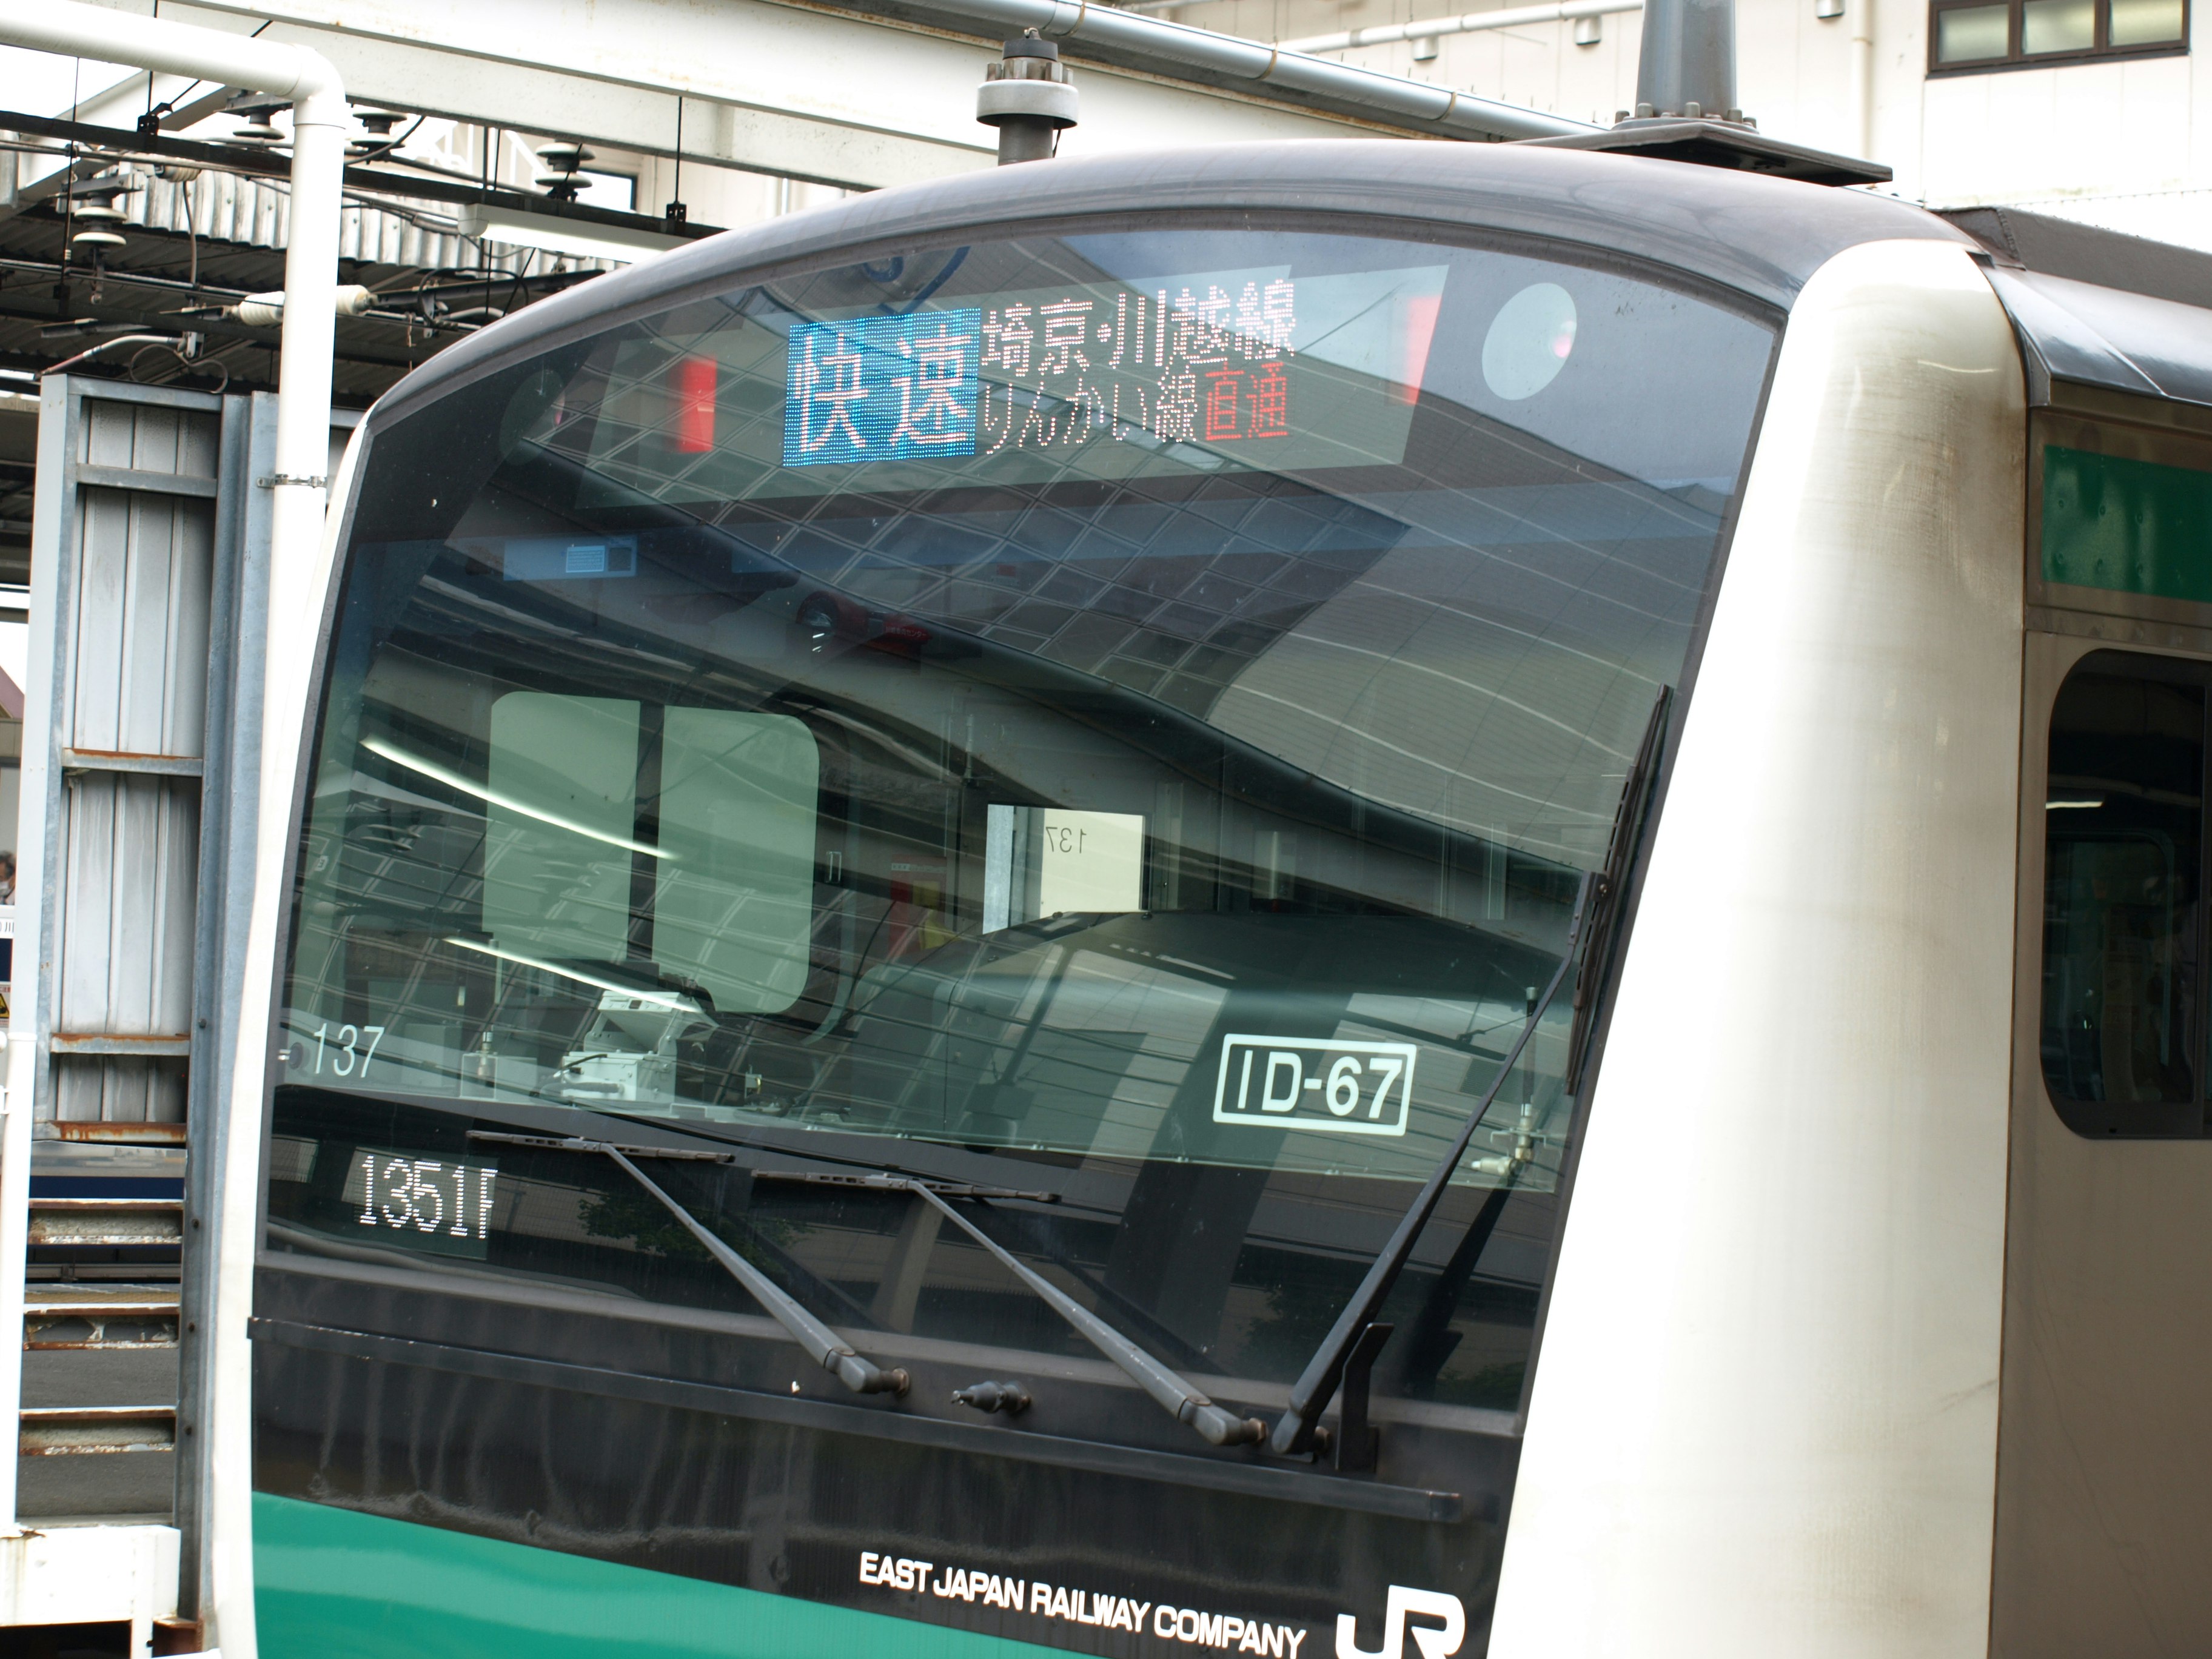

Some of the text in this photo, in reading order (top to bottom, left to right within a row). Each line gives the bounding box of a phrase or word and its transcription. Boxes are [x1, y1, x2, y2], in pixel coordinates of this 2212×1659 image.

[793, 324, 971, 454] 快速
[313, 1023, 384, 1078] 137
[1238, 1050, 1403, 1118] ID-67
[859, 1551, 1307, 1659] EAST JAPAN RAILWAY COMPANY
[1335, 1584, 1466, 1659] JR
